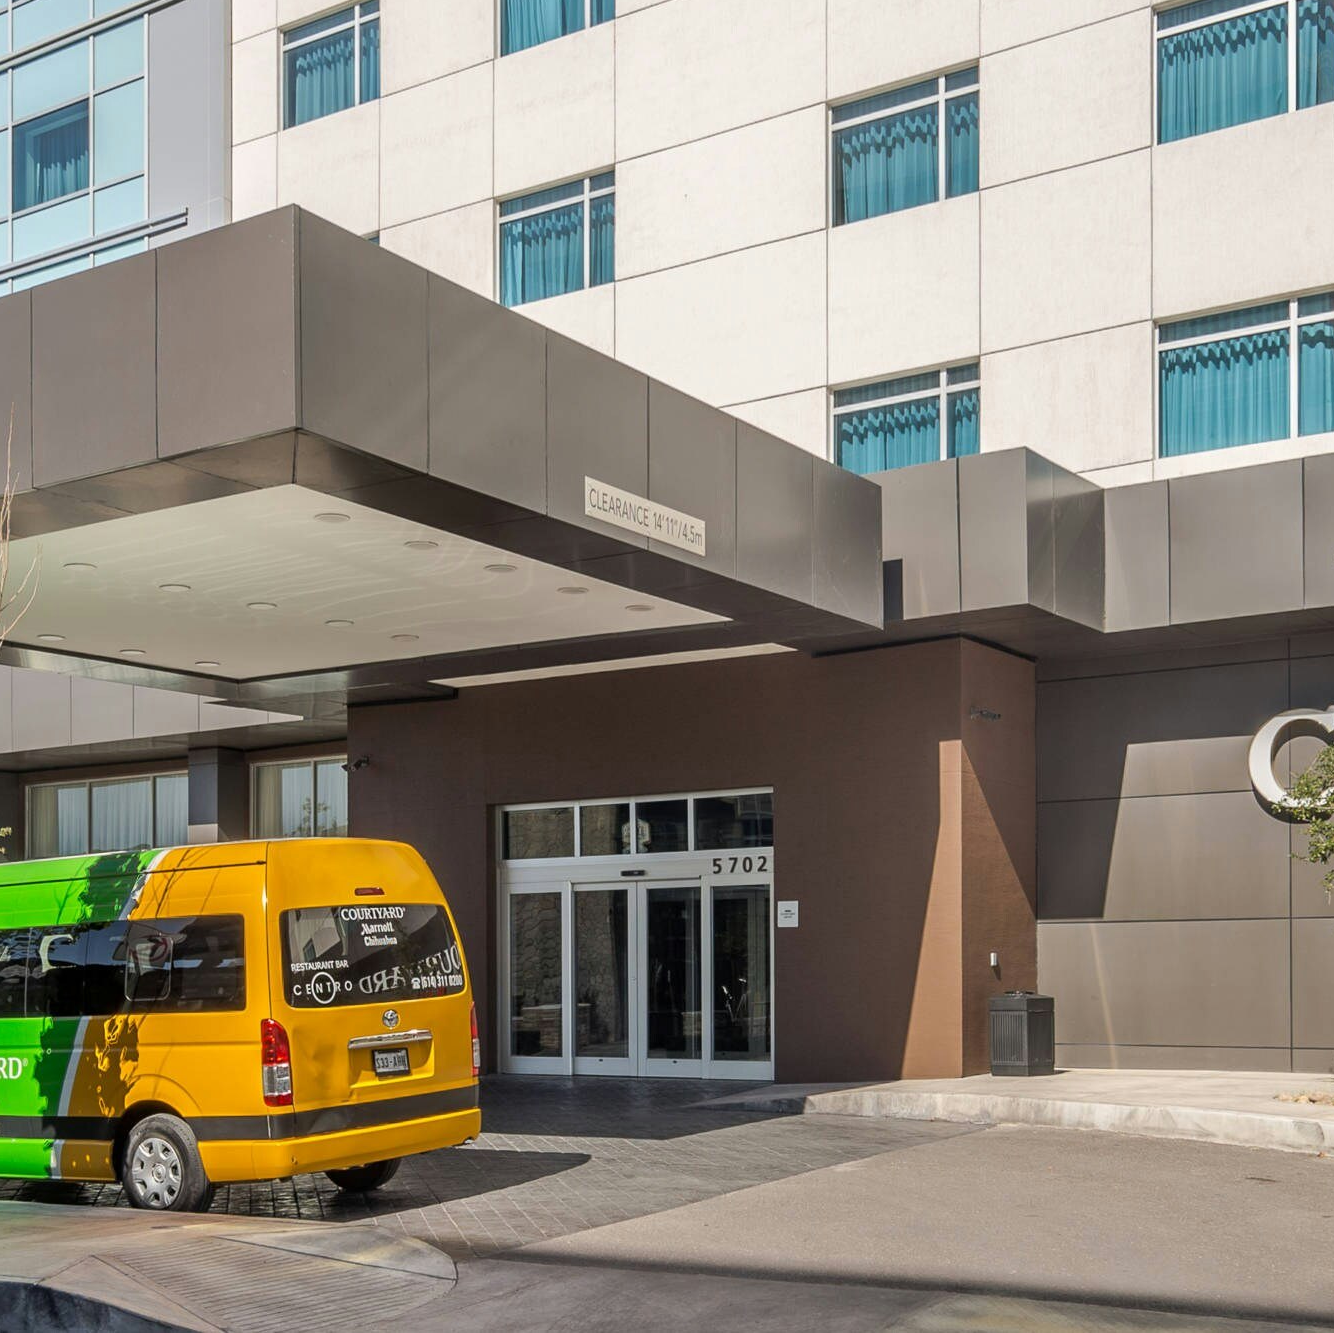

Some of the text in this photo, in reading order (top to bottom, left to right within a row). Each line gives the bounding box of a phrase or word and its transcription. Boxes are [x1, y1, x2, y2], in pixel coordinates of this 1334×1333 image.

[589, 488, 650, 528] CLEARANCE
[712, 855, 768, 875] 5702
[360, 922, 395, 936] Marriott
[364, 936, 398, 947] Chihuahua
[291, 959, 349, 972] RESTAURANT BAR
[293, 979, 353, 996] CENTRO
